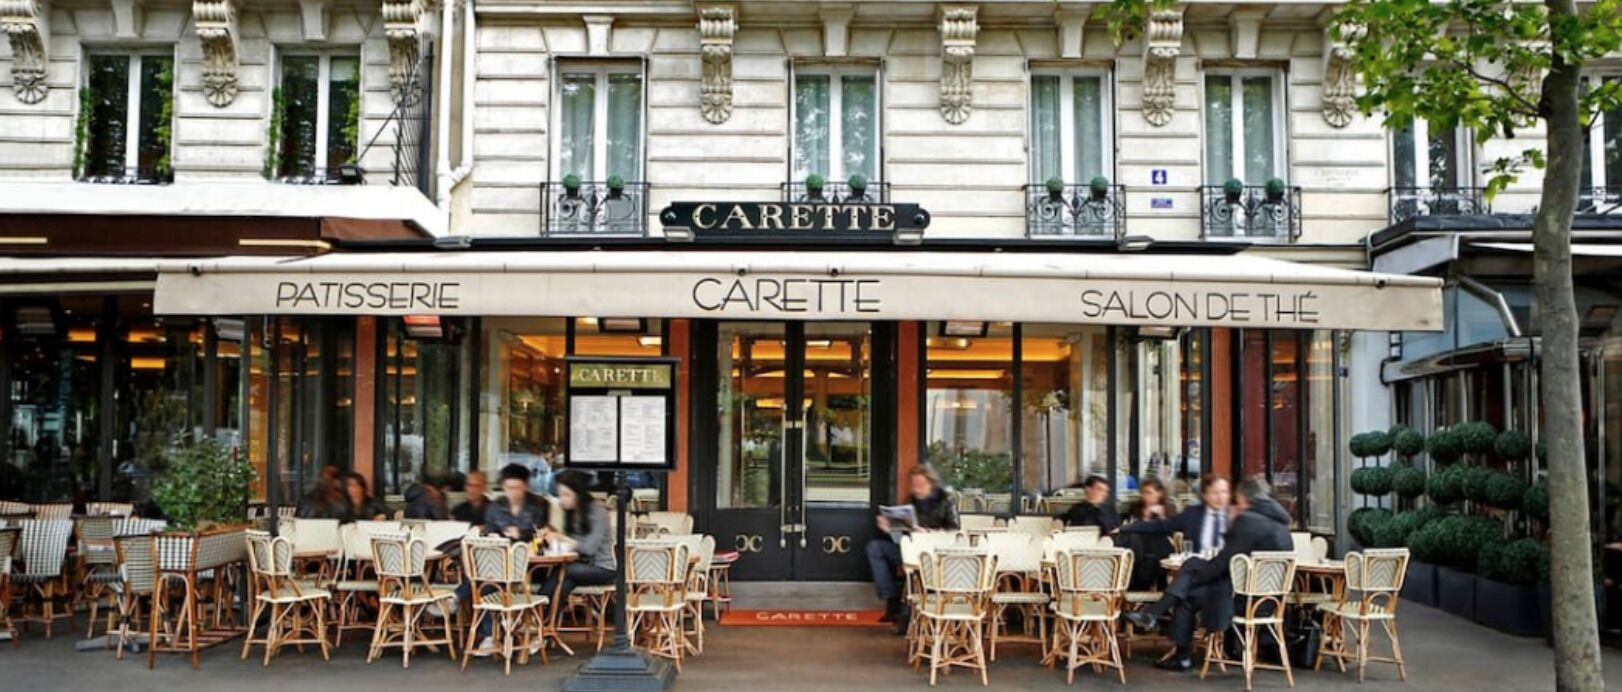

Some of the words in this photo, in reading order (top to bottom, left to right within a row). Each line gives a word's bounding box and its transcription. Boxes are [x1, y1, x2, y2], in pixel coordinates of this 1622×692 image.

[1154, 170, 1164, 184] 4
[692, 204, 896, 231] CARETTE
[275, 282, 460, 309] PATISSERIE
[692, 278, 880, 312] CARETTE
[1080, 289, 1198, 320] SALON
[1206, 292, 1250, 321] DE
[1256, 290, 1319, 323] THÉ
[579, 367, 663, 383] CARETTE
[755, 611, 858, 621] CARETTE
